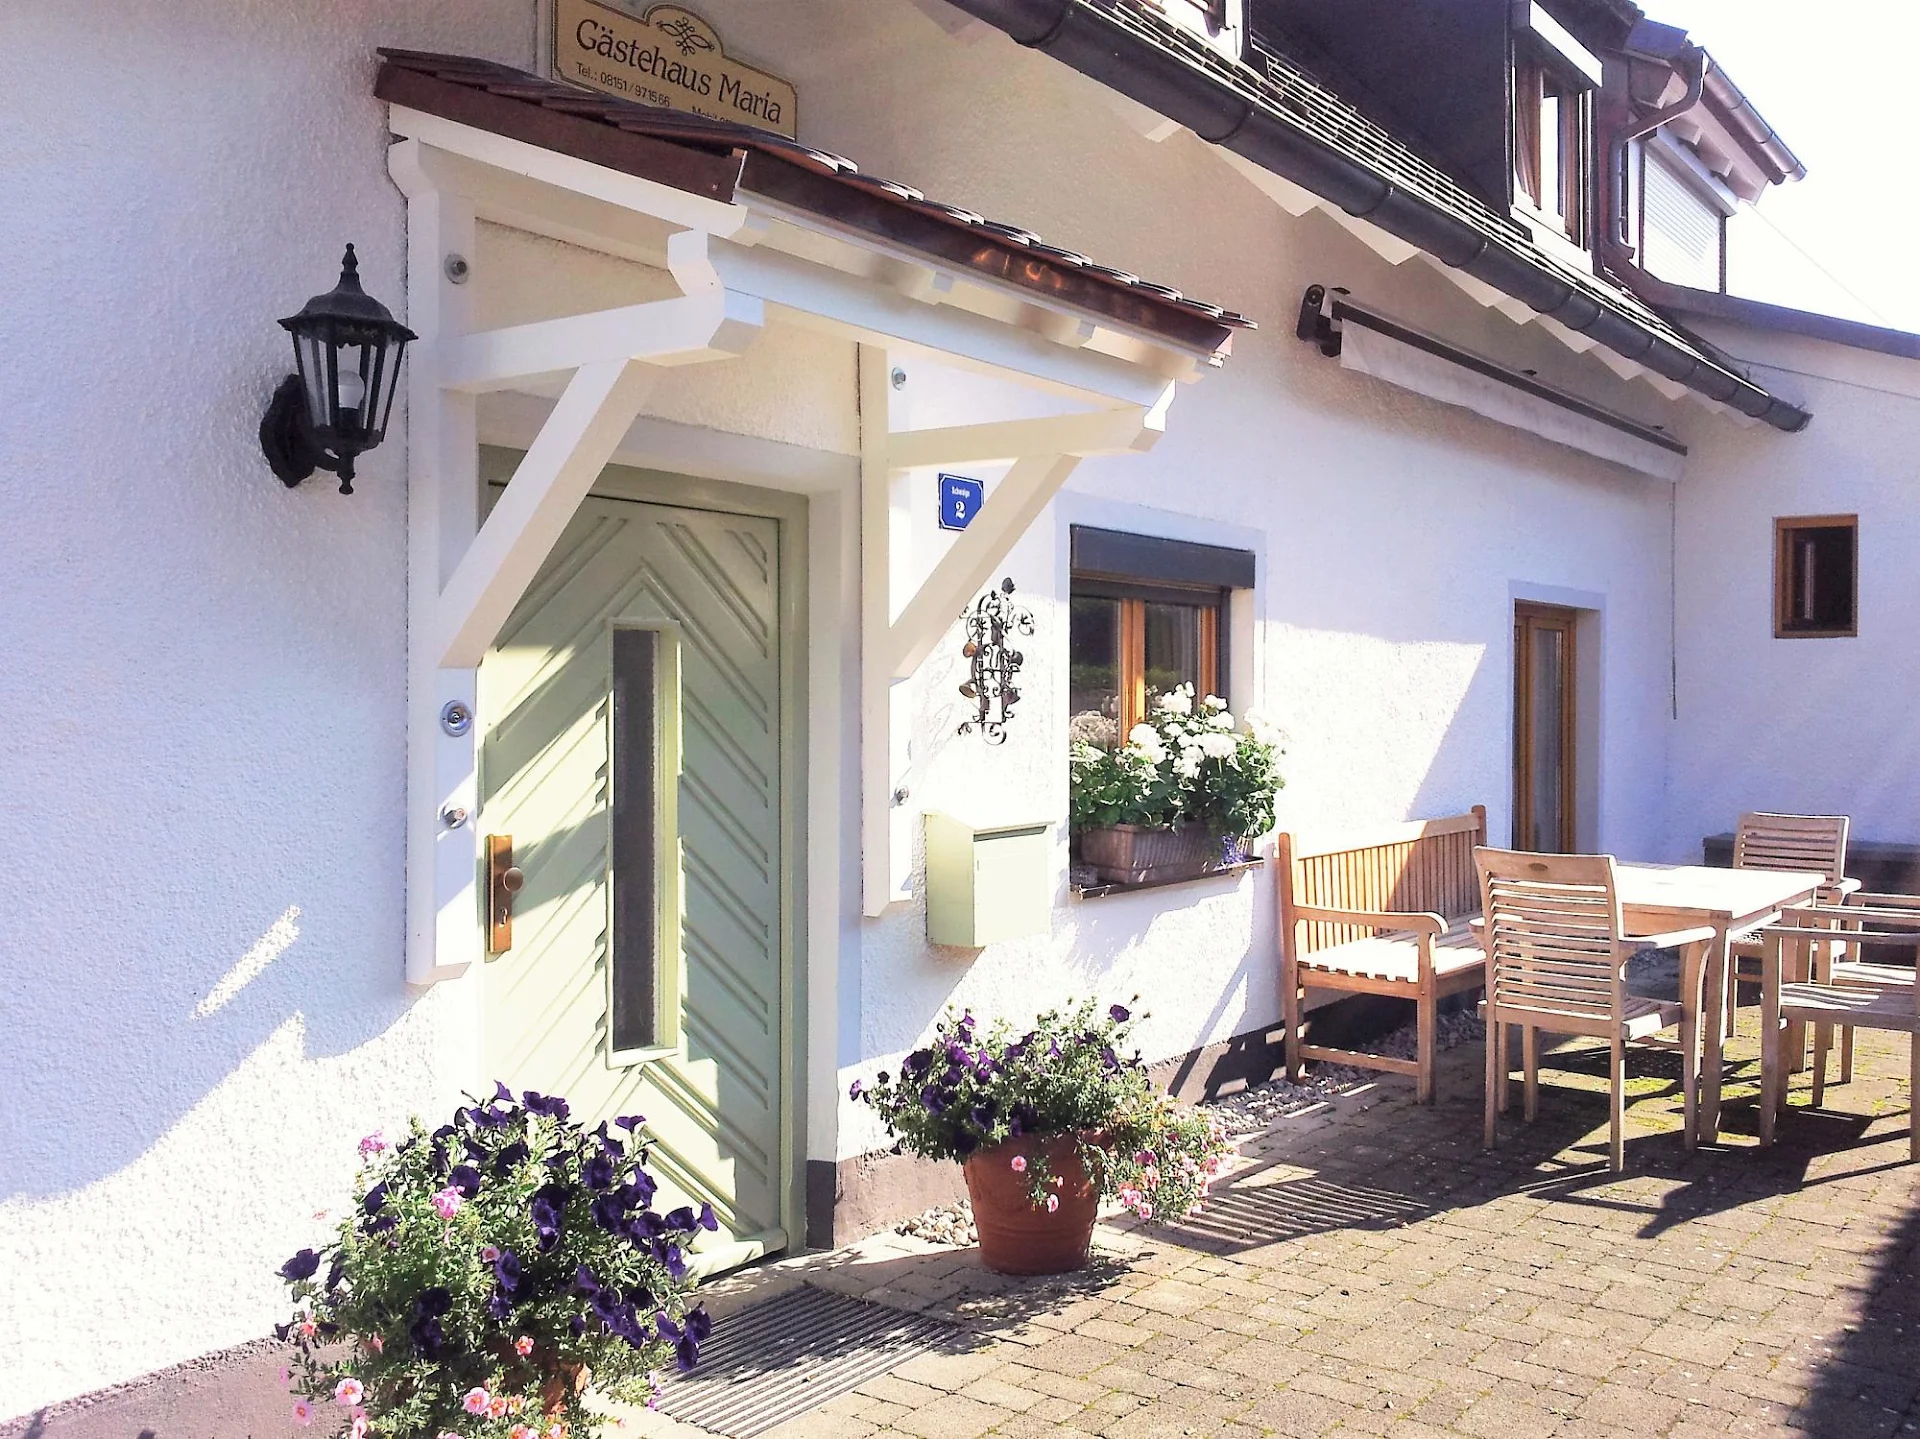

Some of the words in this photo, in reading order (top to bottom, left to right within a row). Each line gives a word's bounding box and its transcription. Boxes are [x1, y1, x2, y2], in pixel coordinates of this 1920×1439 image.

[577, 19, 711, 95] Gästehaus
[718, 74, 781, 124] Maria
[955, 501, 966, 519] 2
